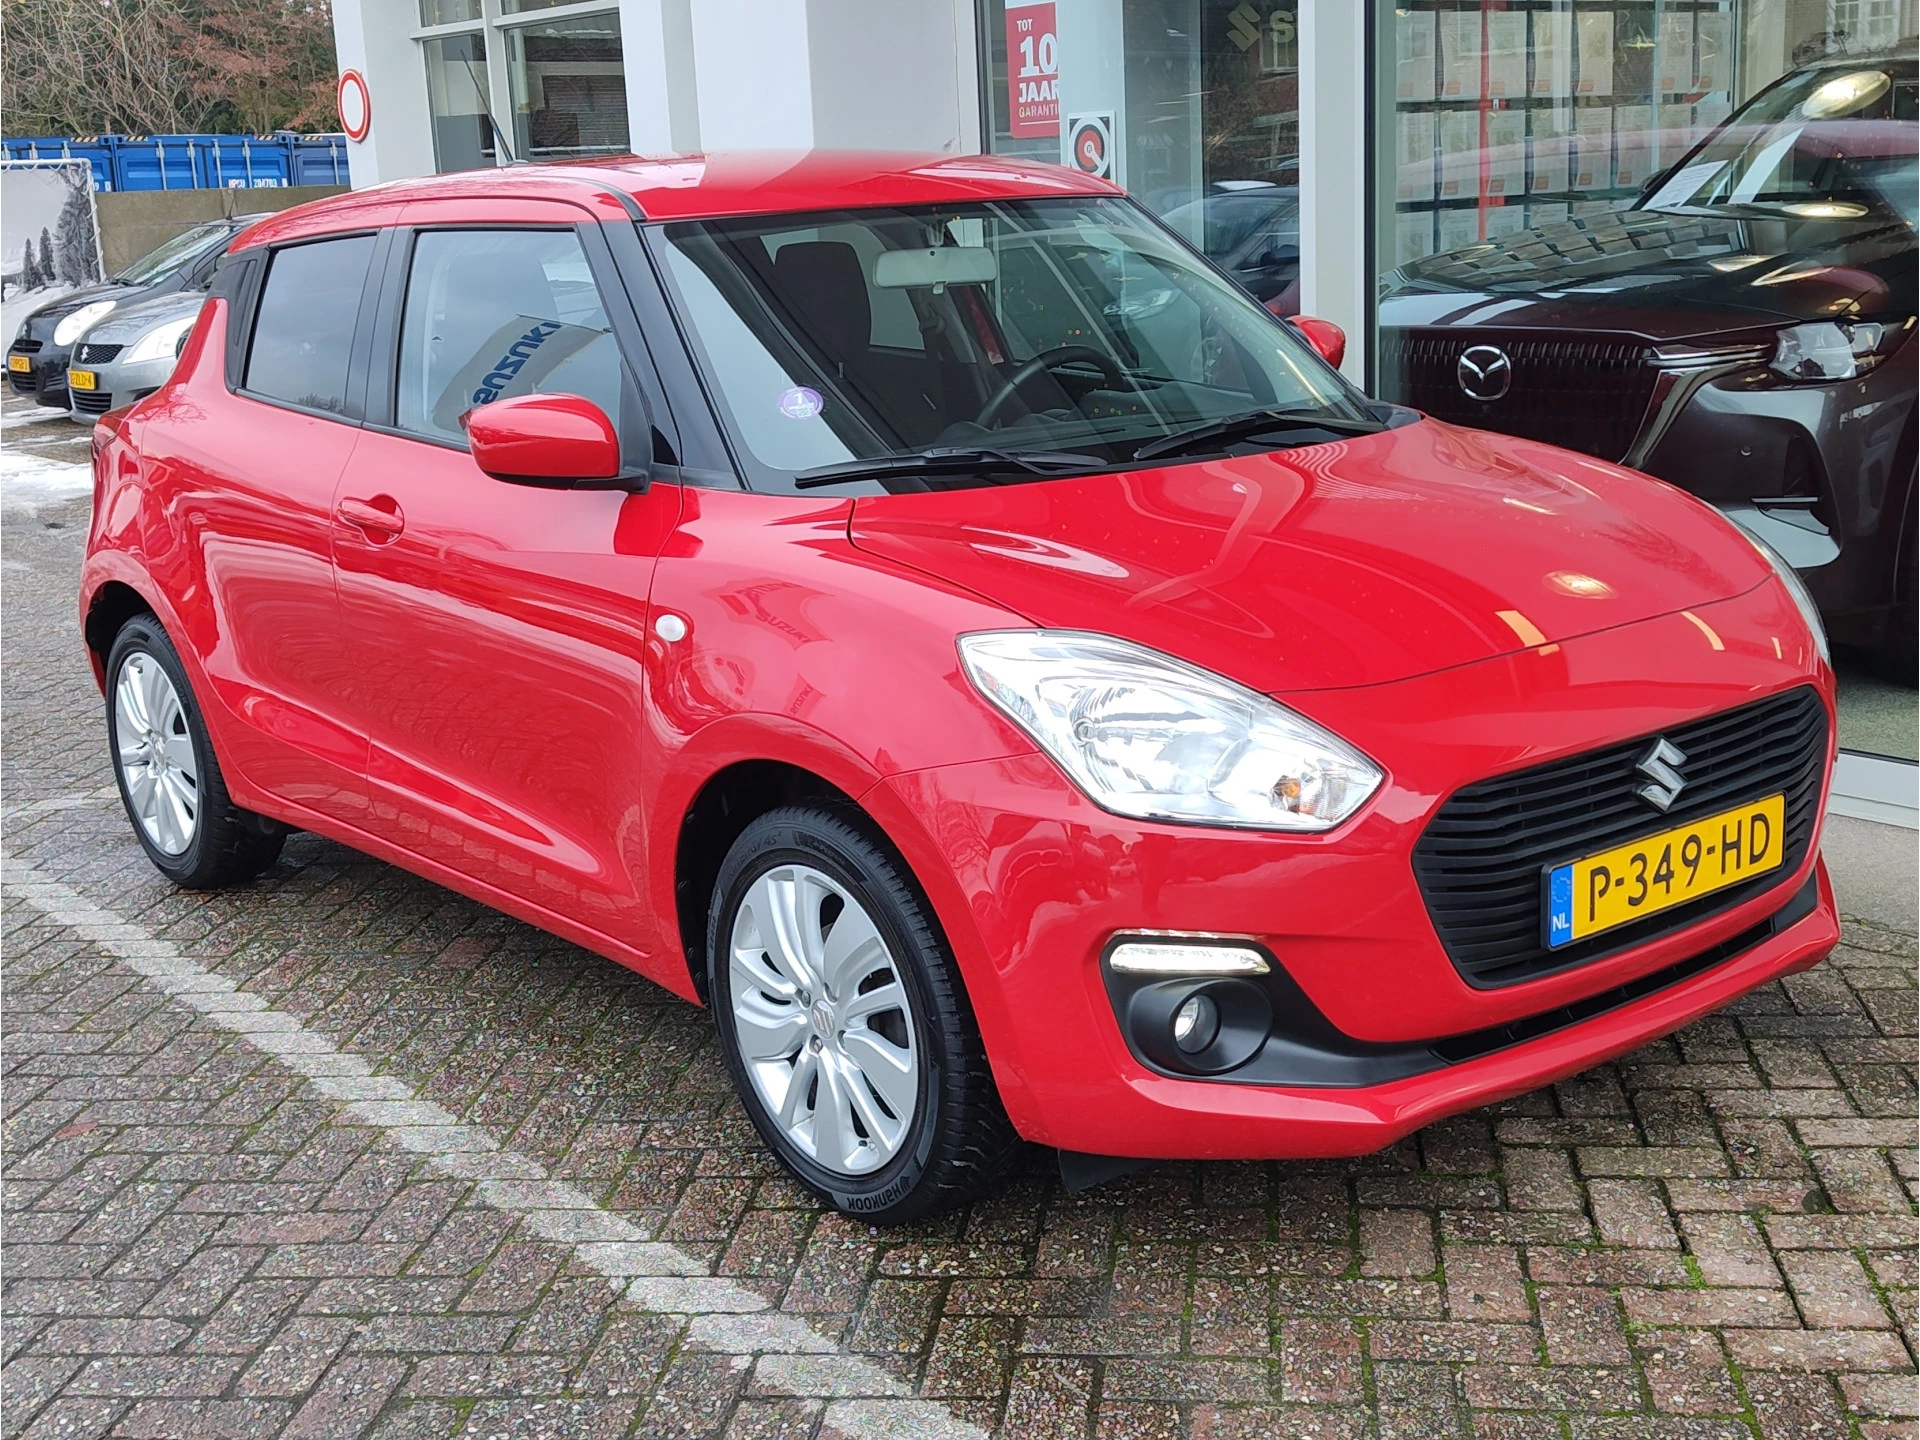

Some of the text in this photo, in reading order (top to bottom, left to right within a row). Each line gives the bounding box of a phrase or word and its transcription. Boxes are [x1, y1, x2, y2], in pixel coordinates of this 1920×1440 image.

[1017, 18, 1033, 32] TOT
[1019, 33, 1059, 76] 10
[1018, 80, 1060, 103] JAAR
[1589, 813, 1771, 922] P-349-HD
[1552, 911, 1570, 932] NL
